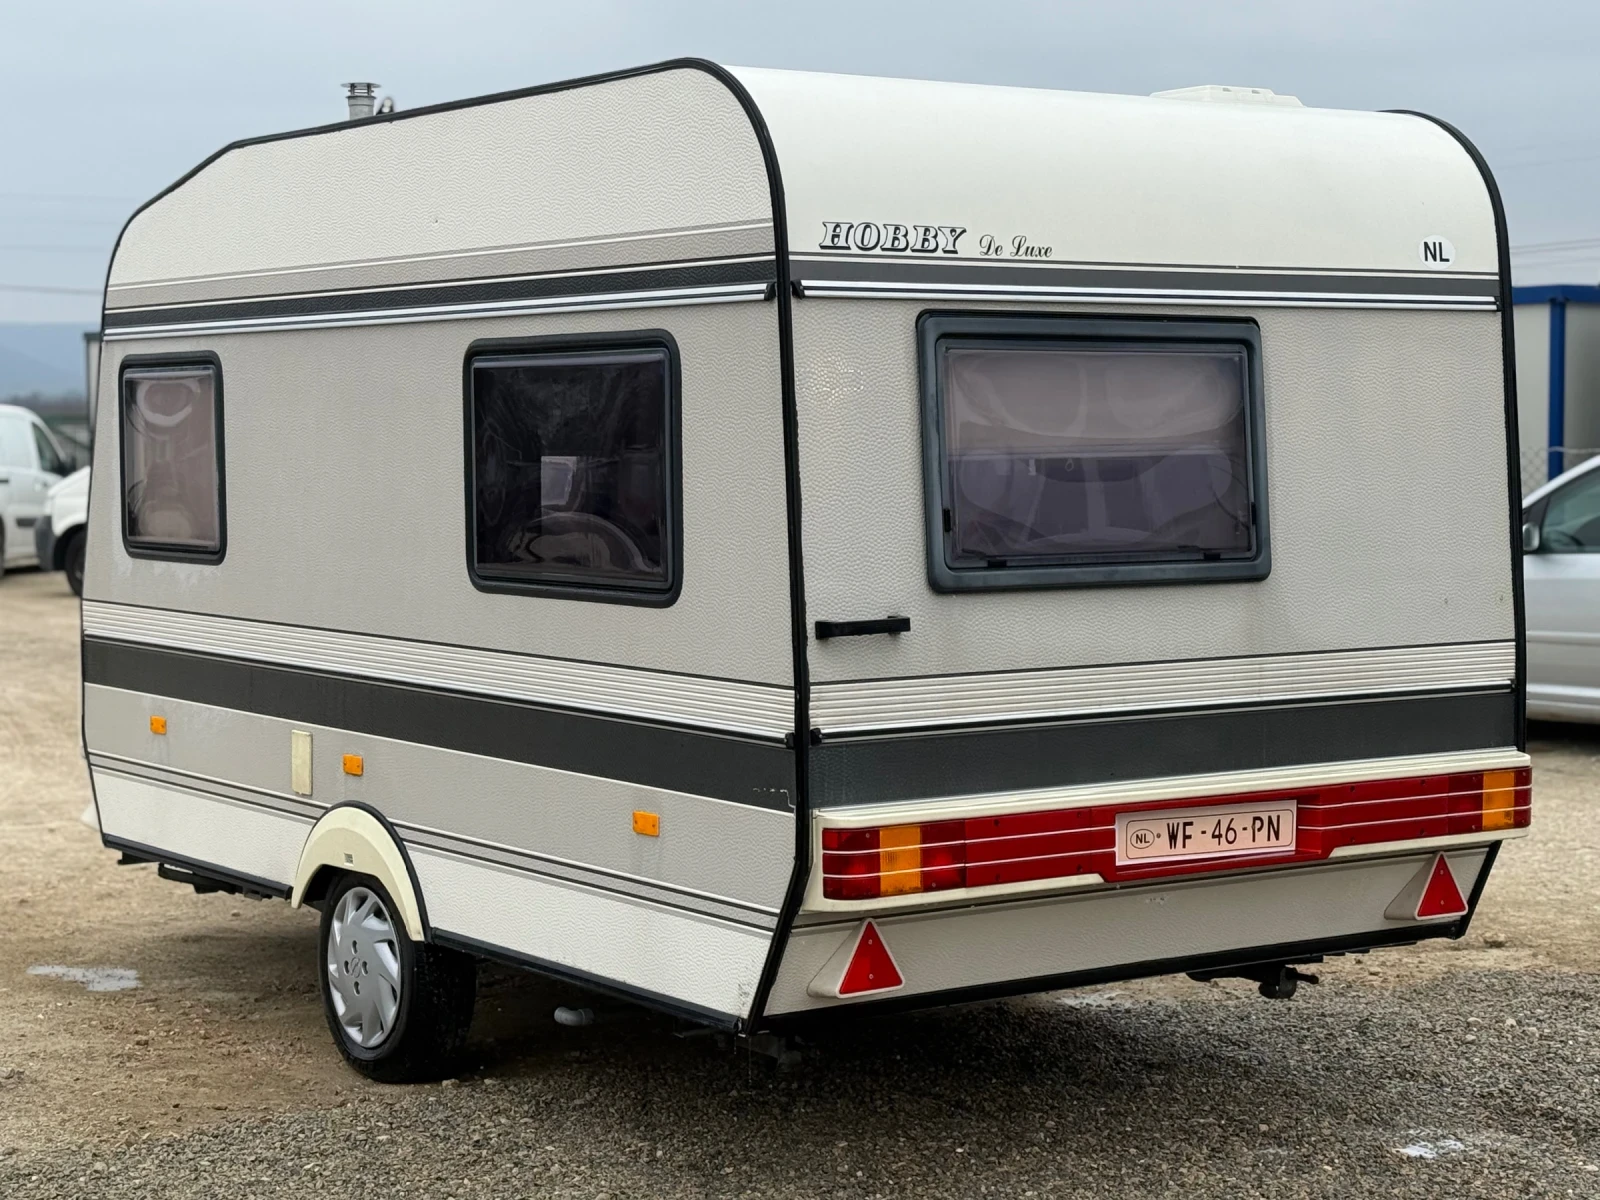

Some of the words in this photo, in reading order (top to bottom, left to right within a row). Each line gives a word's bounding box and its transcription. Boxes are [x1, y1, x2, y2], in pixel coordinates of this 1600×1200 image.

[819, 221, 967, 254] HOBBY
[979, 234, 1004, 257] De
[1009, 235, 1053, 258] Luxe
[1423, 241, 1450, 262] NL
[1135, 833, 1150, 844] NL
[1166, 814, 1281, 850] WF-46-PN
